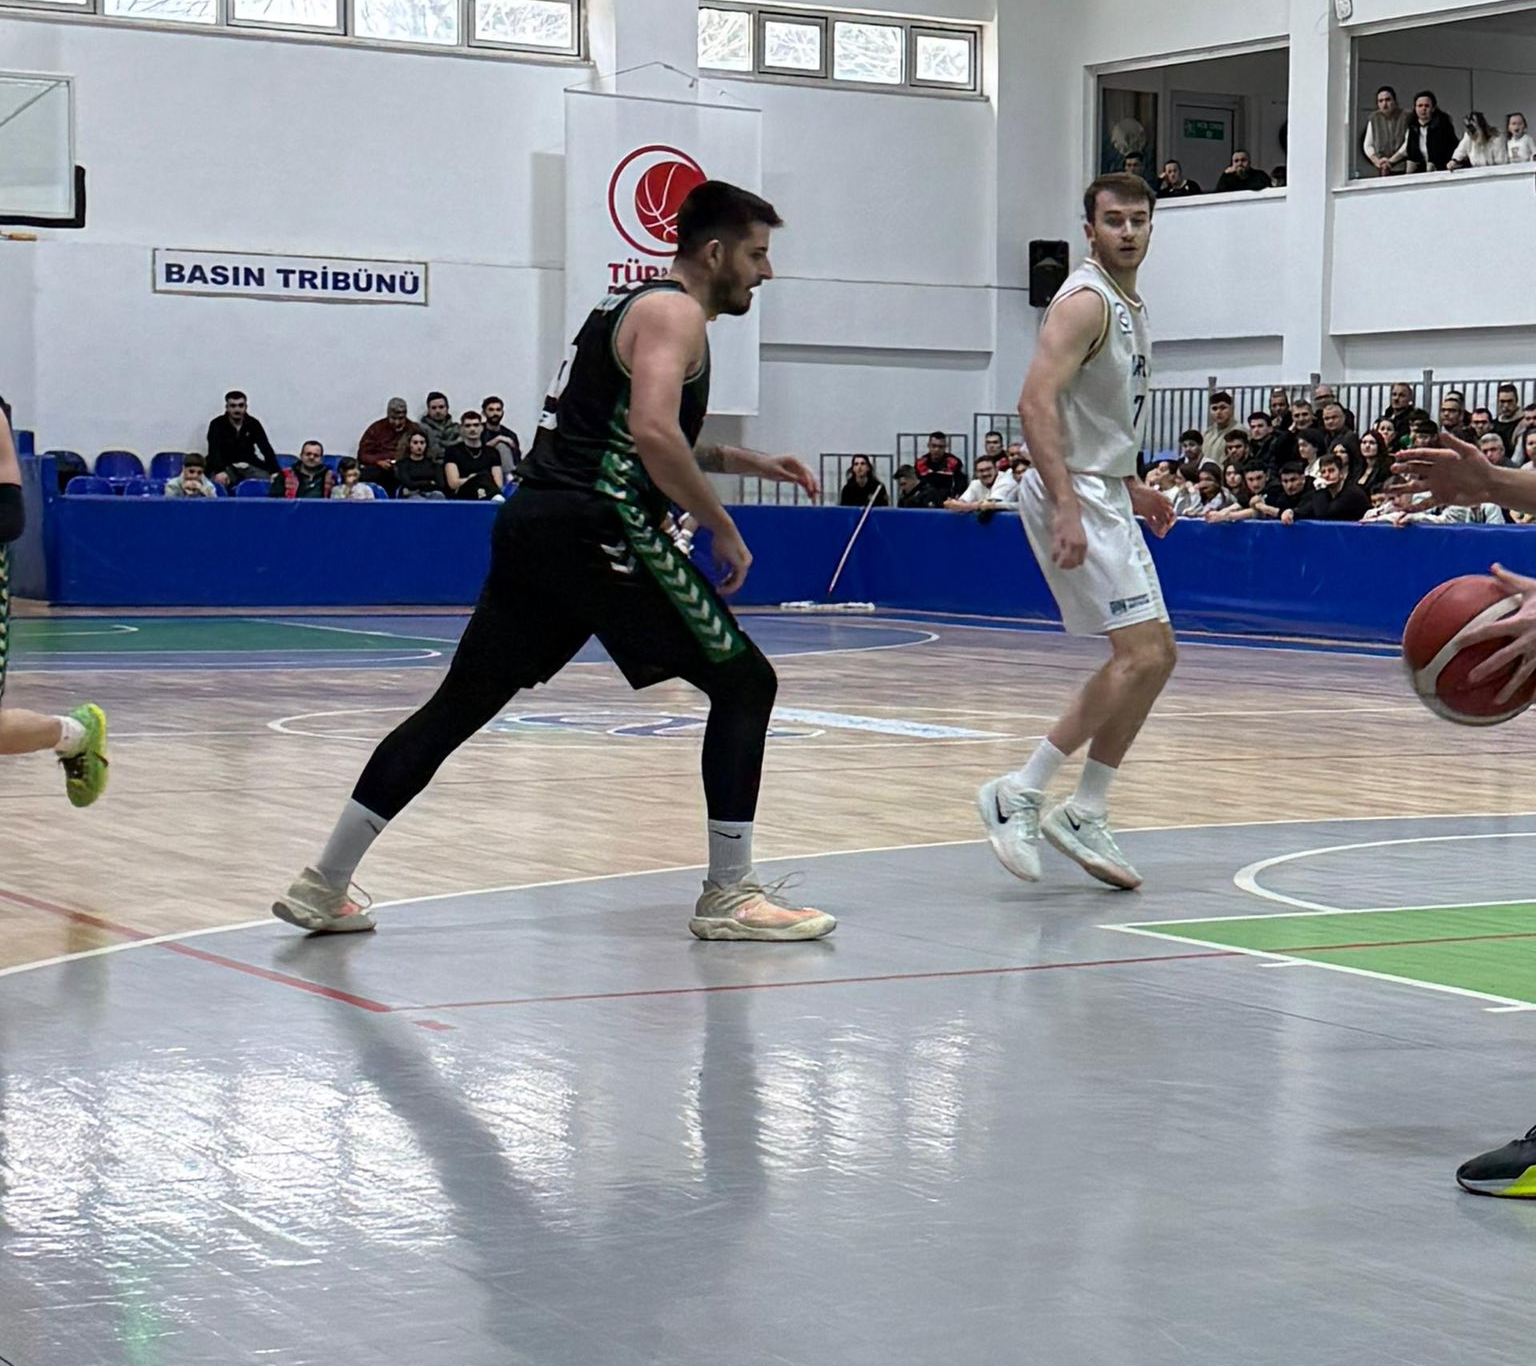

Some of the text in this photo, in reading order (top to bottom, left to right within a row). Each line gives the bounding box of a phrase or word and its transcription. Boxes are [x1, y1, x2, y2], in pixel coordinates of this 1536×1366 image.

[164, 262, 420, 295] BASIN TRİBÜNÜ
[608, 257, 668, 283] TÜR
